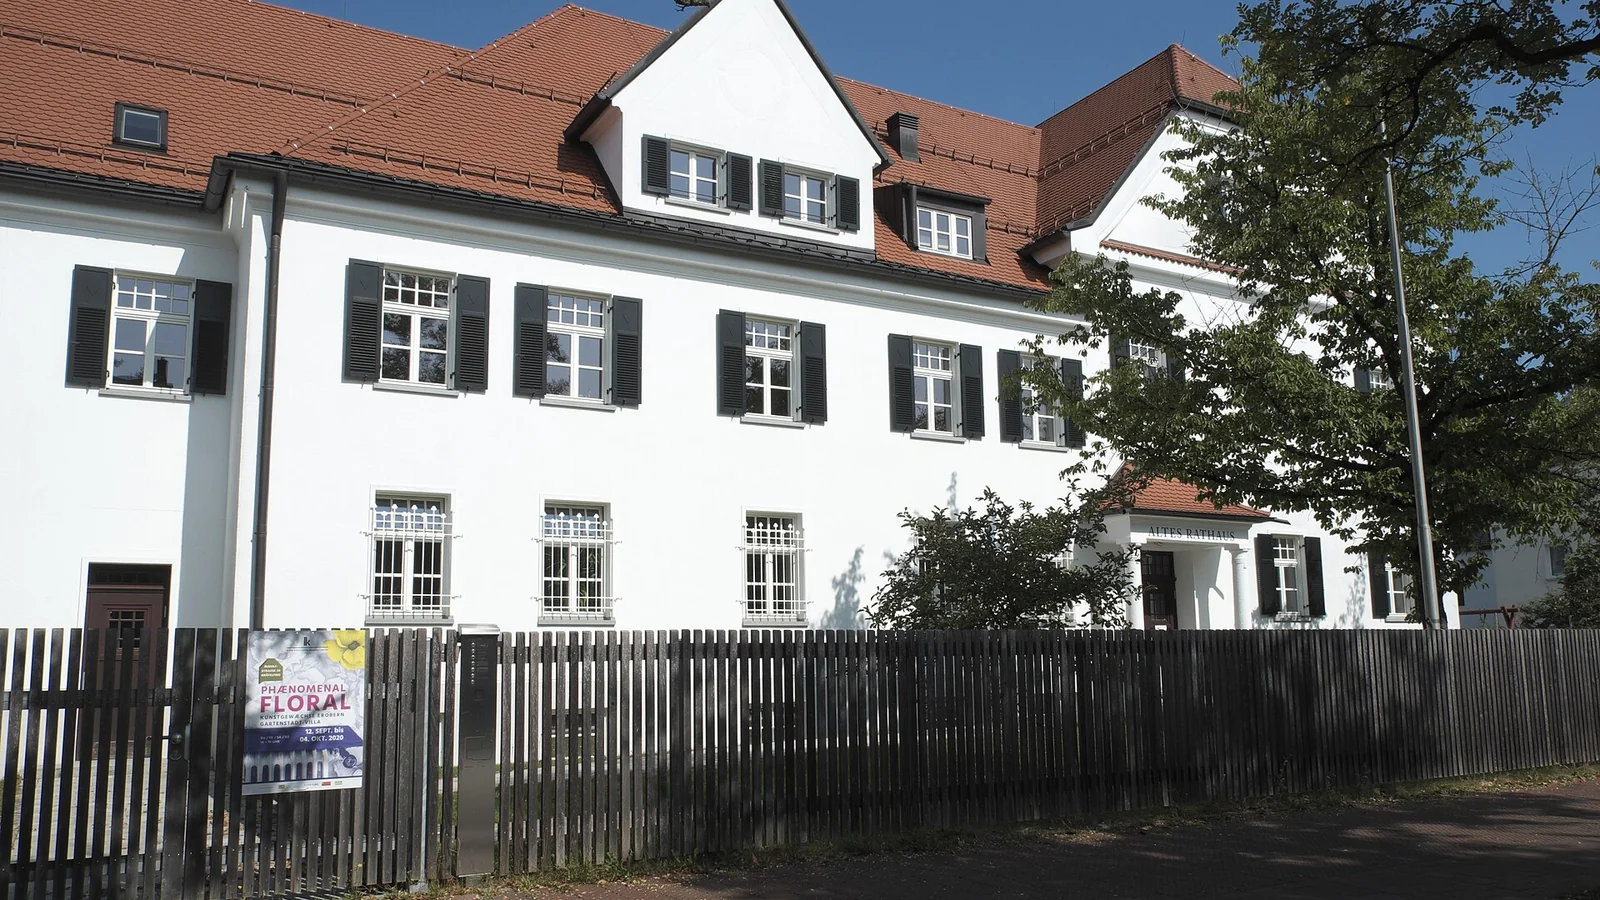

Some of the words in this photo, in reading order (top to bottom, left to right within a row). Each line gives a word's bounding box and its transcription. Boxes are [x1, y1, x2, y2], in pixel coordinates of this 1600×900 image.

[1148, 526, 1182, 538] ALTES
[1186, 528, 1235, 541] RATHAUS
[261, 684, 346, 694] PHÆNOMENAL
[260, 694, 351, 713] FLORAL
[315, 727, 333, 735] SEPT.
